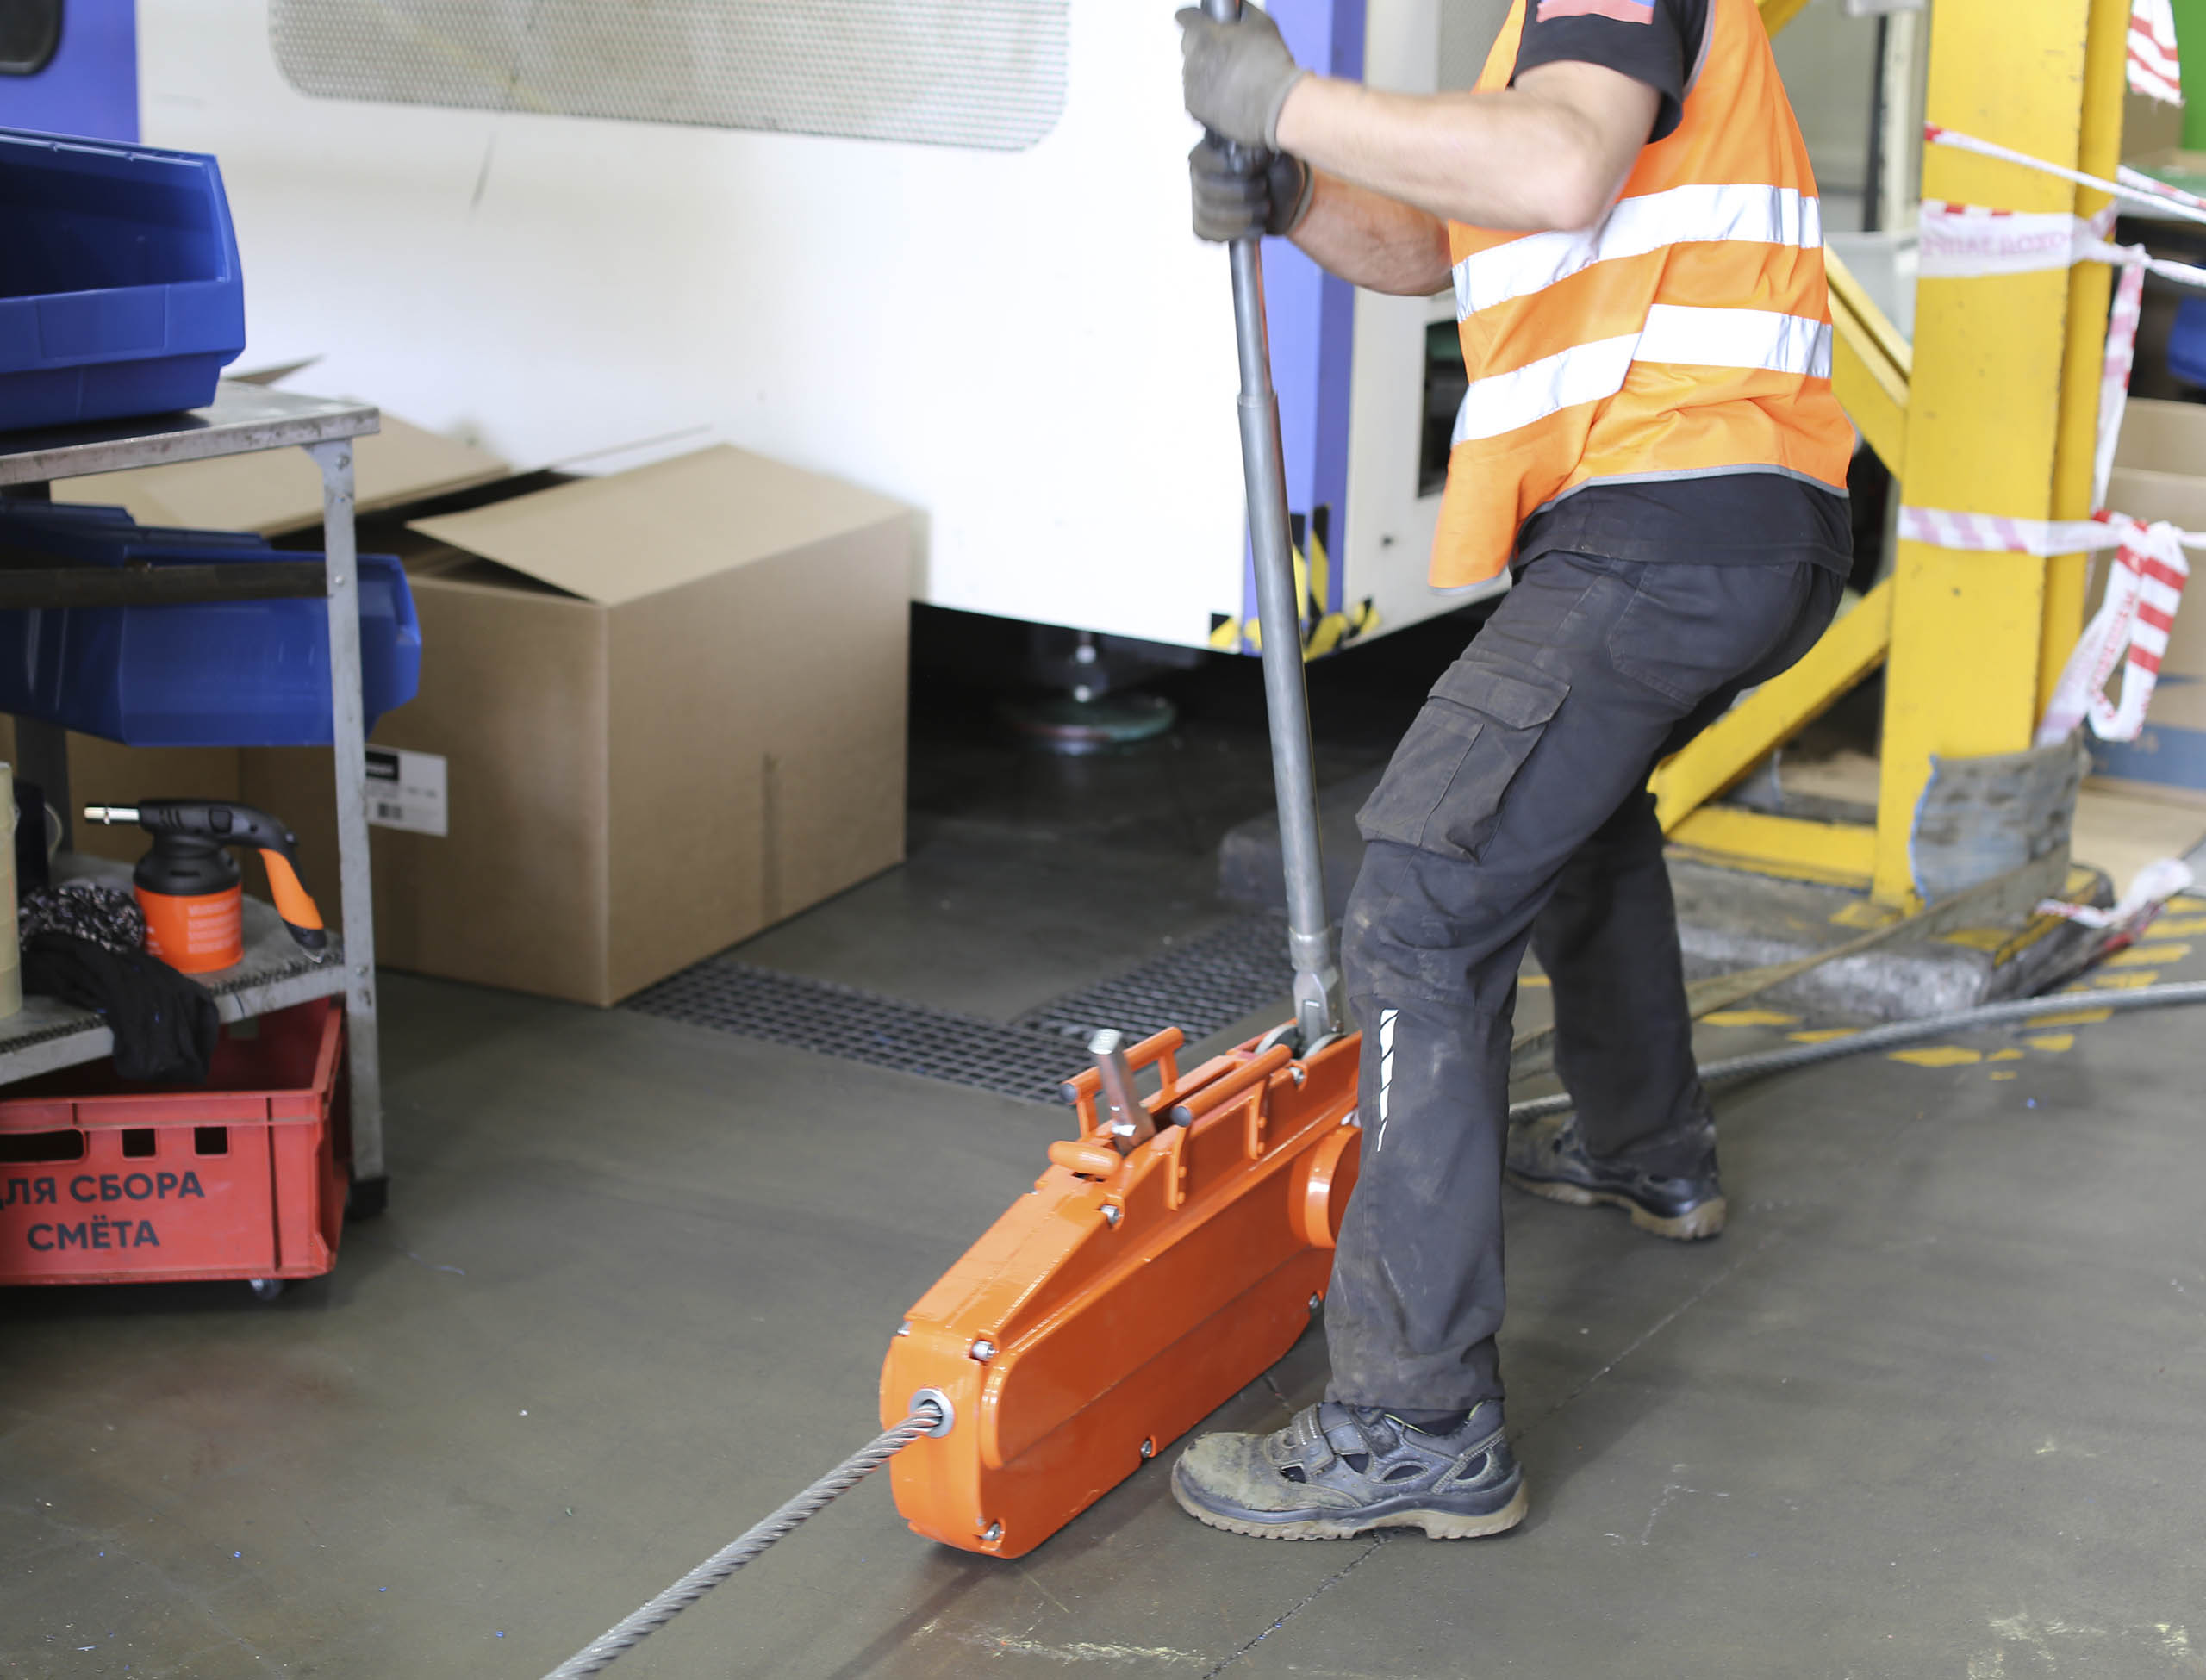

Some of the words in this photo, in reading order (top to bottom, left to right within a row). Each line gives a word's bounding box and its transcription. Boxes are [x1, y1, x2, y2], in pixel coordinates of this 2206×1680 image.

[0, 1177, 57, 1210] ЛЯ
[70, 1172, 205, 1202] СБОРА
[28, 1215, 160, 1251] СМЁТА
